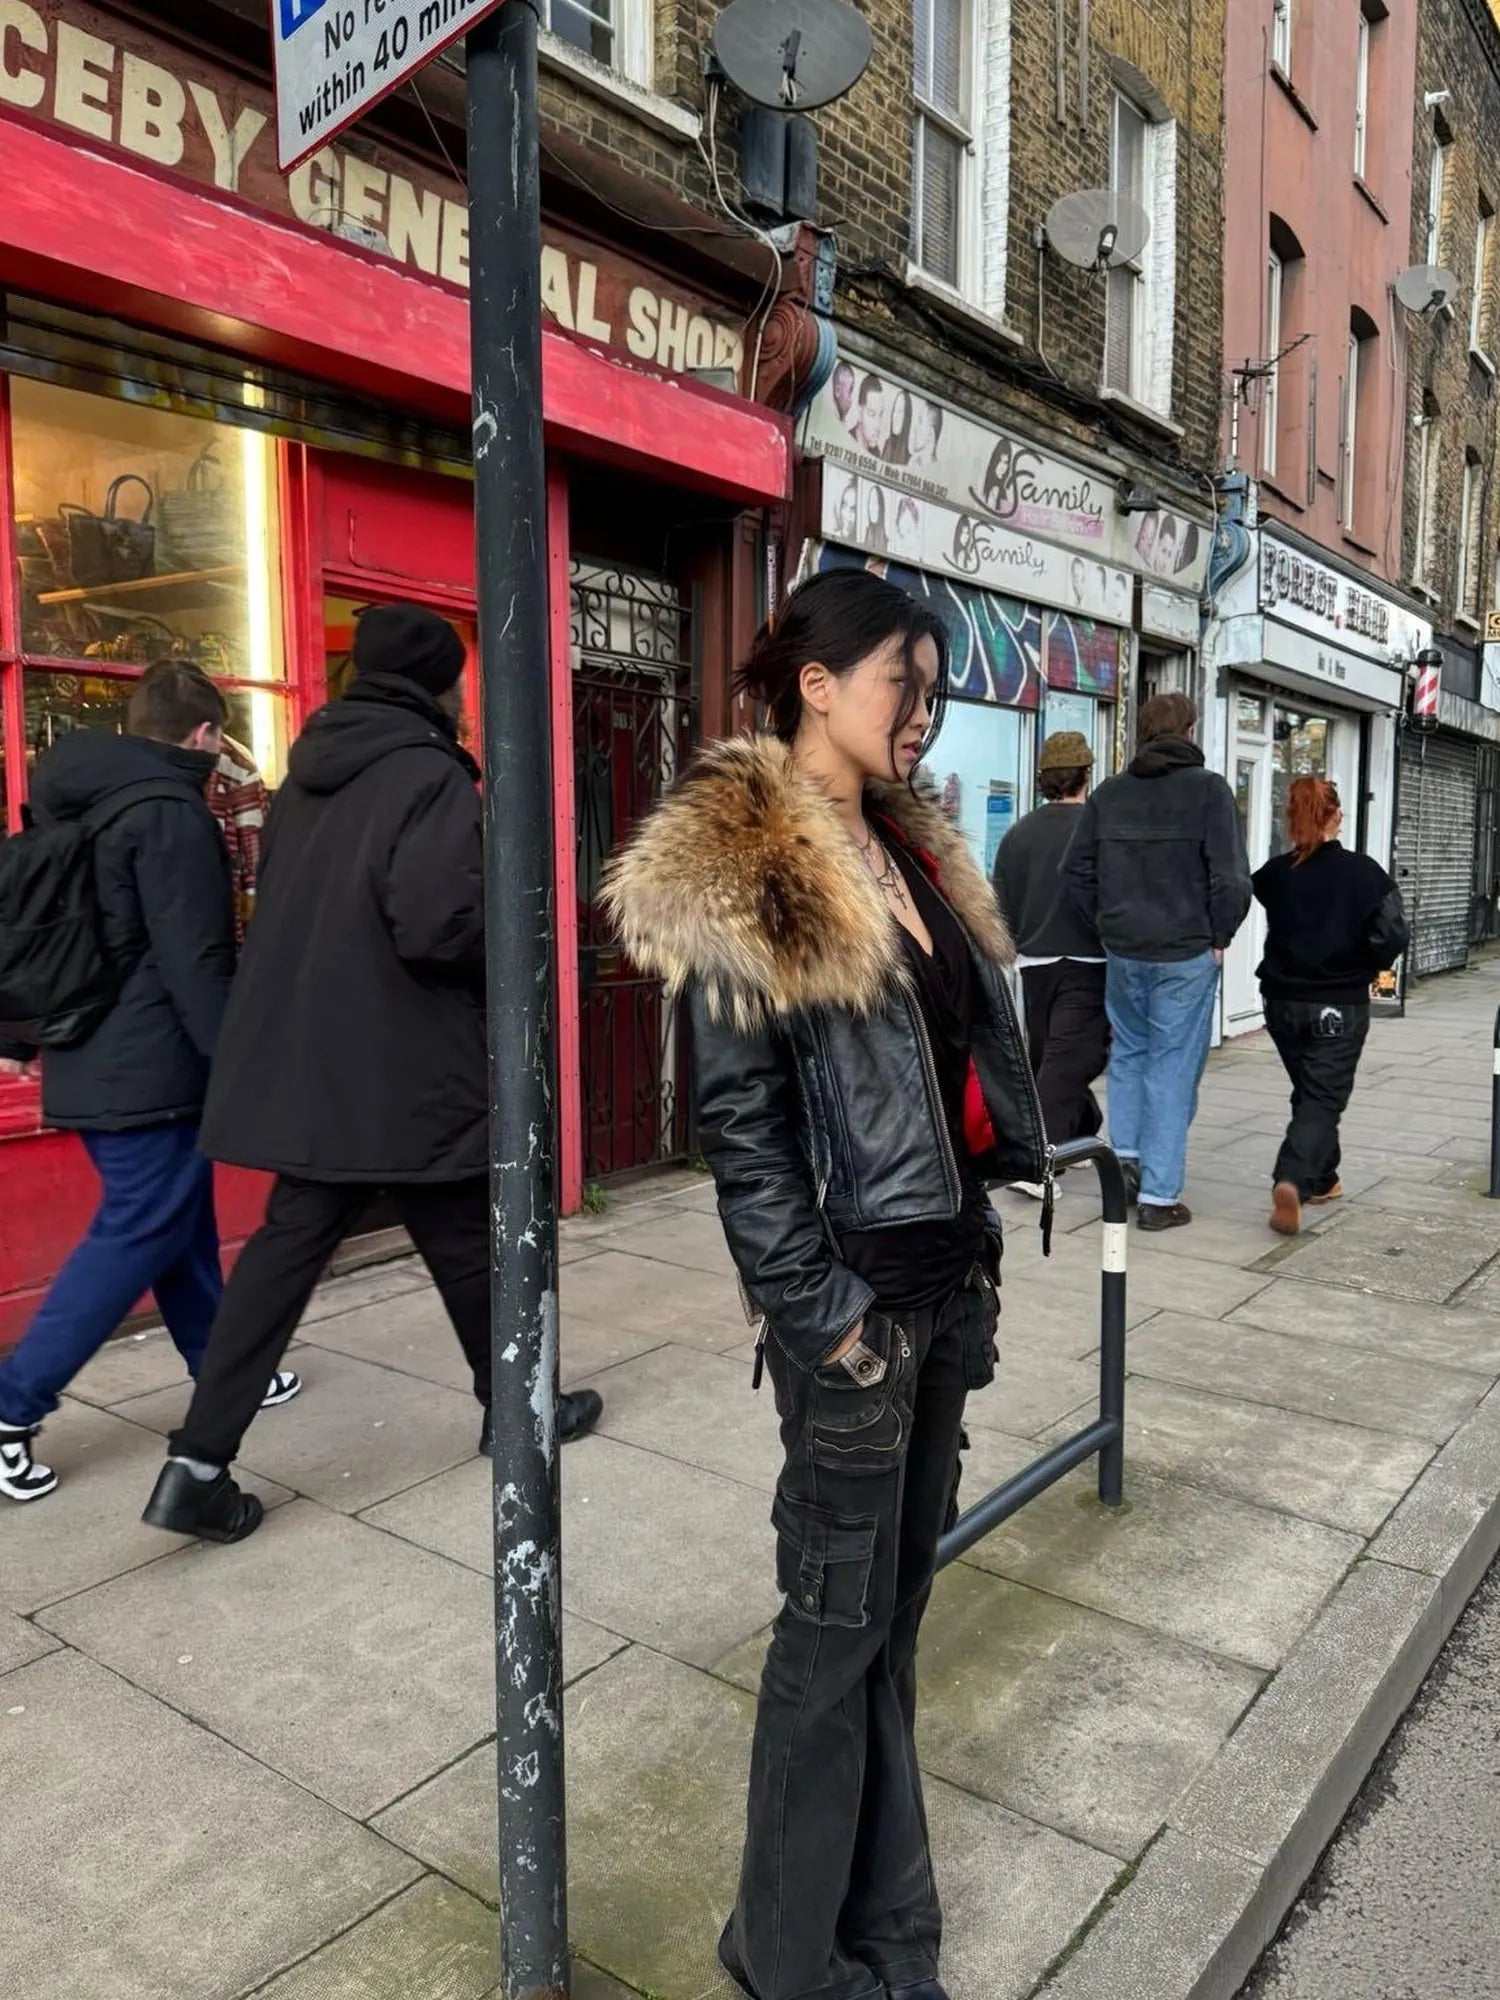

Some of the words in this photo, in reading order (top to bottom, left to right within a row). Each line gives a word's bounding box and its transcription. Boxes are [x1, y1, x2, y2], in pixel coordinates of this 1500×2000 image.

[324, 11, 355, 58] No
[299, 61, 365, 135] within
[373, 16, 408, 71] 40
[289, 145, 611, 344] GENEAL
[626, 286, 745, 390] SHOP
[969, 448, 1104, 526] Family
[943, 520, 1048, 576] Family
